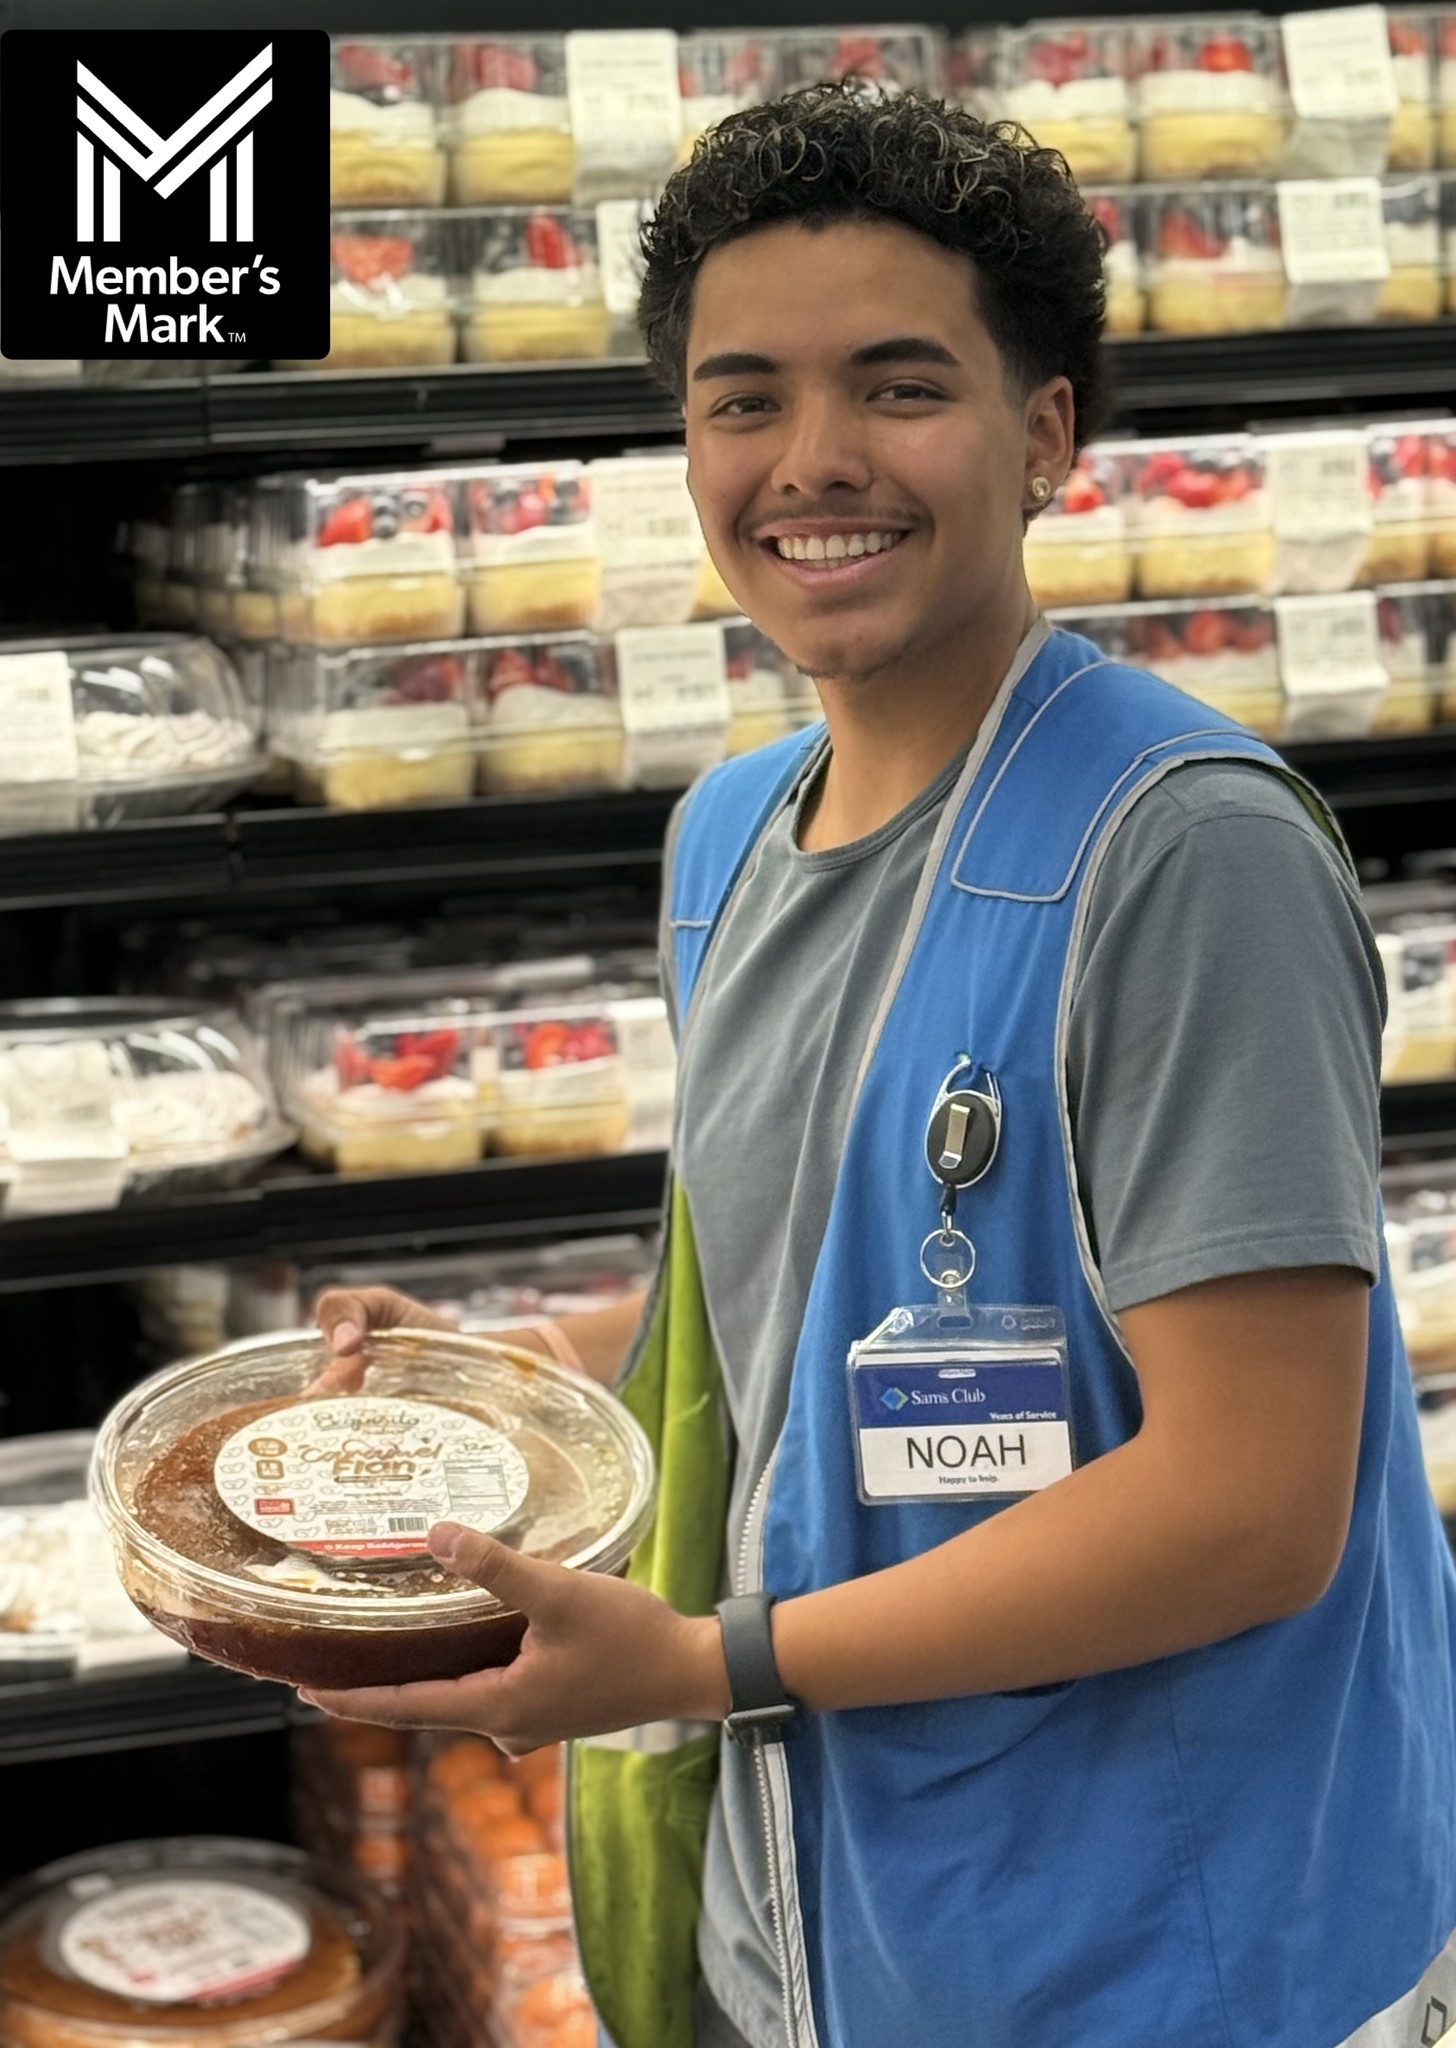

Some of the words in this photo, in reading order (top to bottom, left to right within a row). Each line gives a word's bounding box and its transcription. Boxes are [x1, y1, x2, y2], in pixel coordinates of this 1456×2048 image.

[951, 1388, 986, 1404] Club
[989, 1412, 1014, 1421] Years
[1015, 1411, 1024, 1420] of
[1025, 1410, 1057, 1420] Service
[300, 1439, 443, 1464] Caramel
[907, 1434, 1027, 1469] NOAH
[332, 1458, 416, 1476] Flan
[938, 1476, 967, 1486] Happy
[968, 1475, 977, 1483] to
